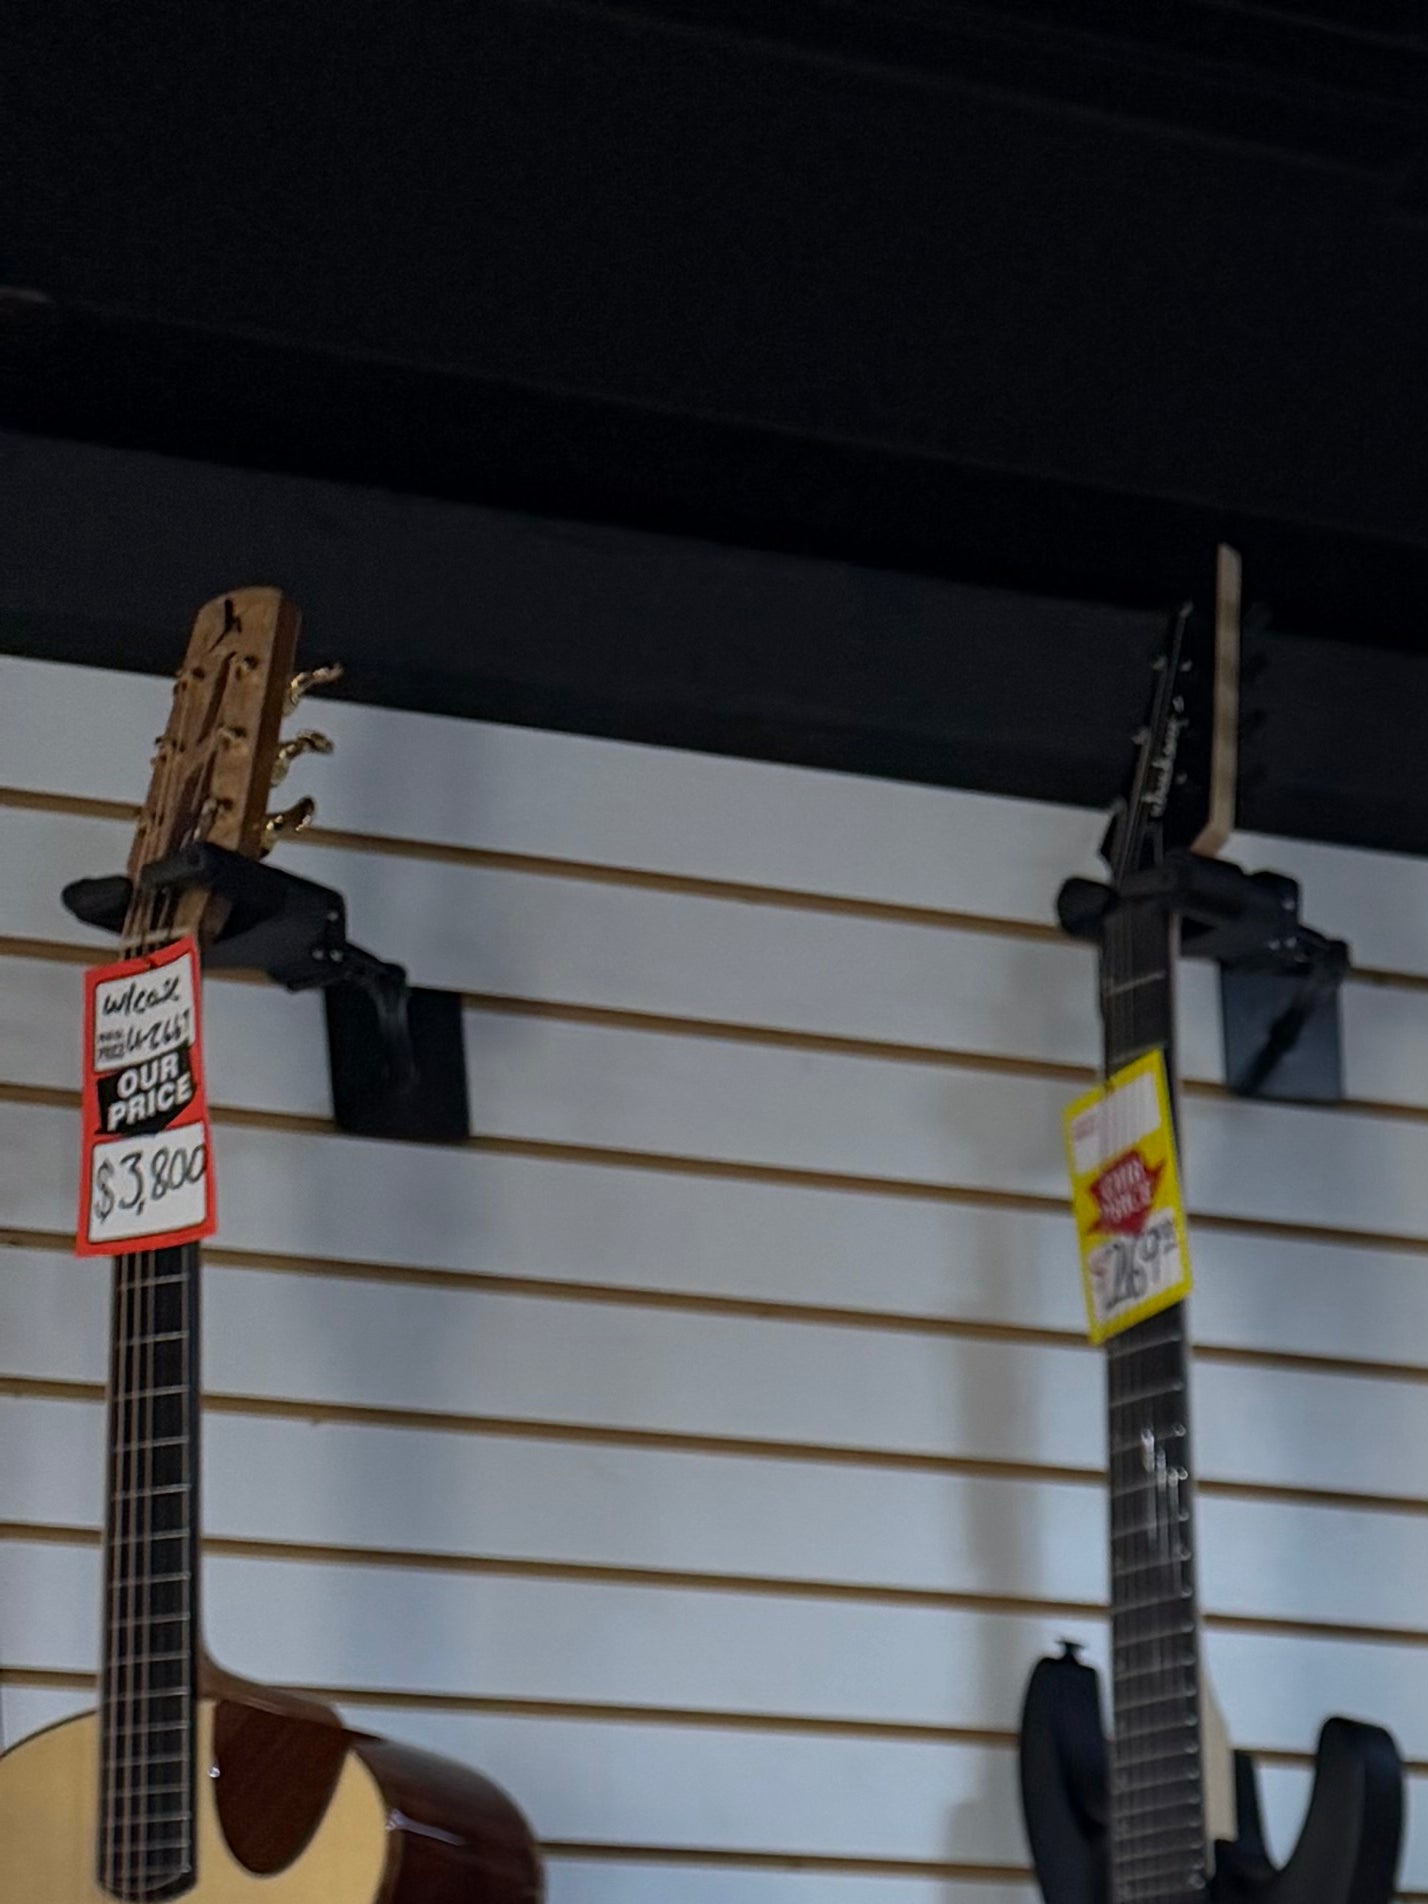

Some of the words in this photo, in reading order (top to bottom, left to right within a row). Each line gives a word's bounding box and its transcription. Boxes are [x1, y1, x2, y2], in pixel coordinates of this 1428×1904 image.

[107, 1072, 193, 1132] PRICE
[116, 1051, 180, 1100] OUR
[94, 1144, 206, 1222] $3,800
